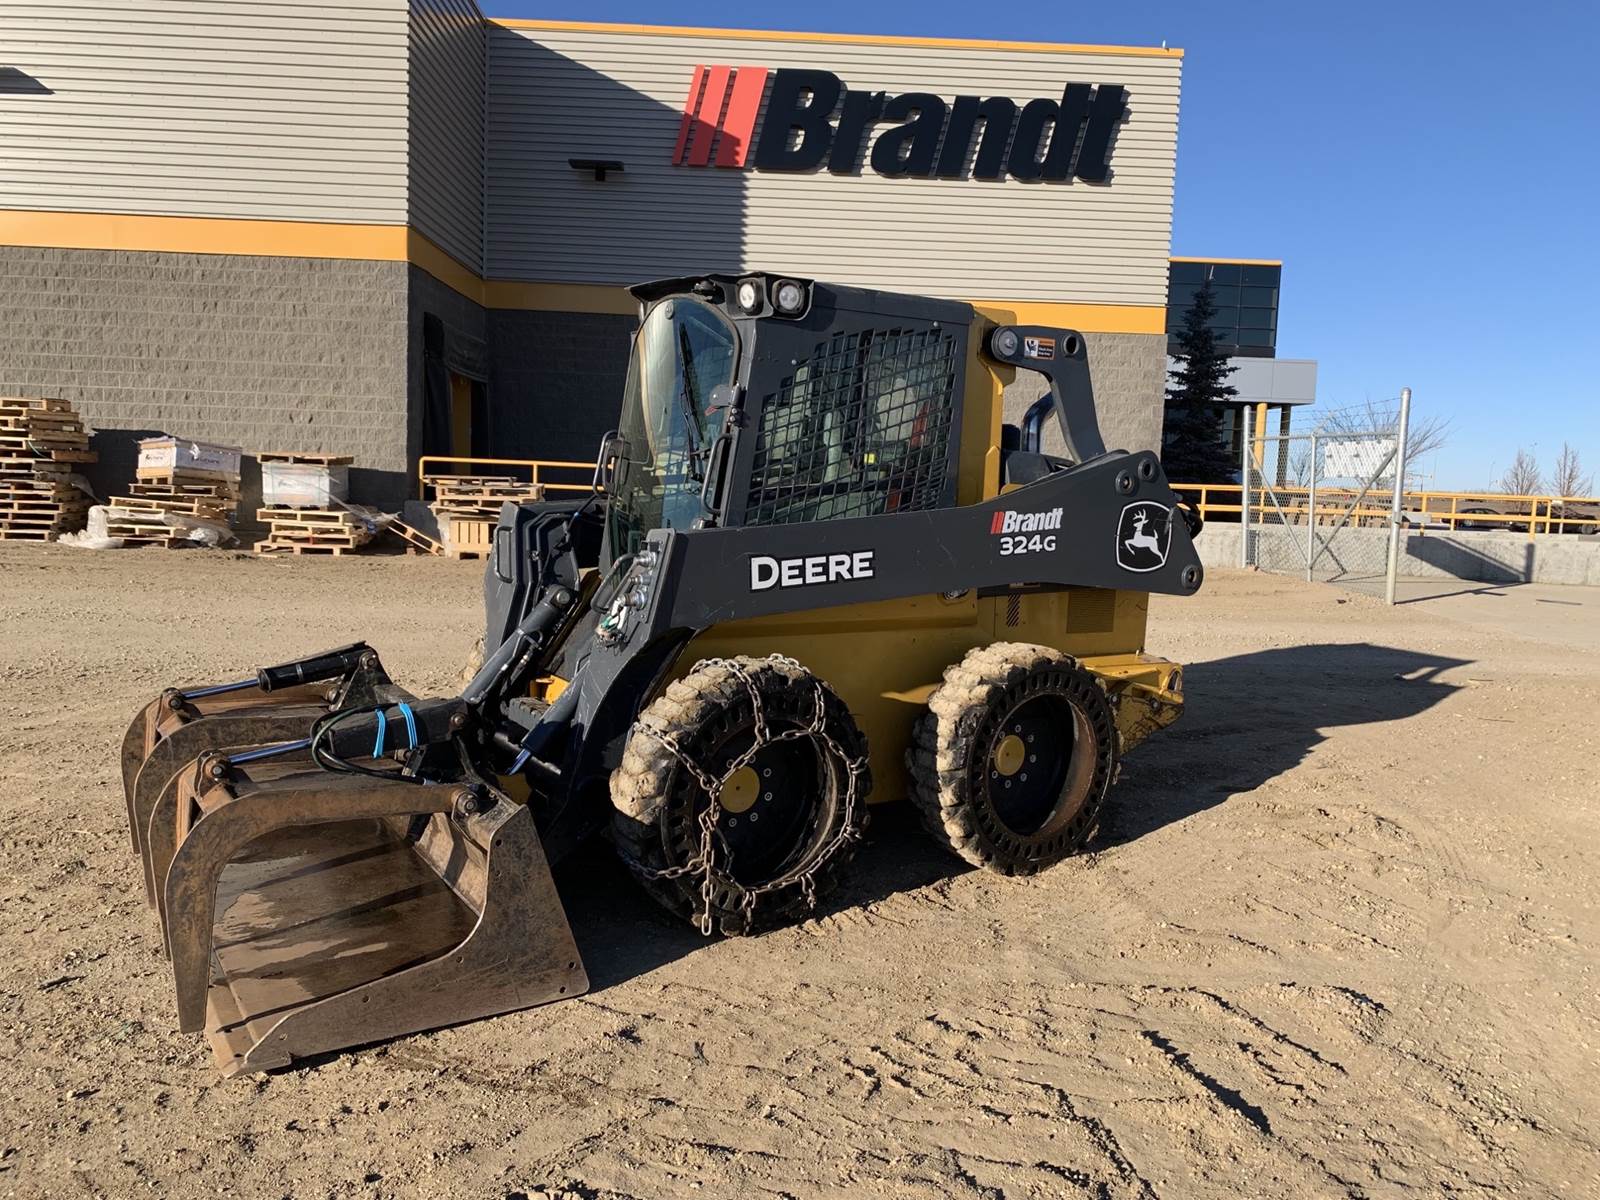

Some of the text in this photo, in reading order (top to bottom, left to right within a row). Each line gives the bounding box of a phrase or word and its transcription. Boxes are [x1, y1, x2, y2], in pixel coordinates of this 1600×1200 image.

[754, 67, 1126, 185] Brandt
[1001, 507, 1063, 534] Brandt
[1000, 534, 1057, 556] 324G
[750, 551, 874, 590] DEERE
